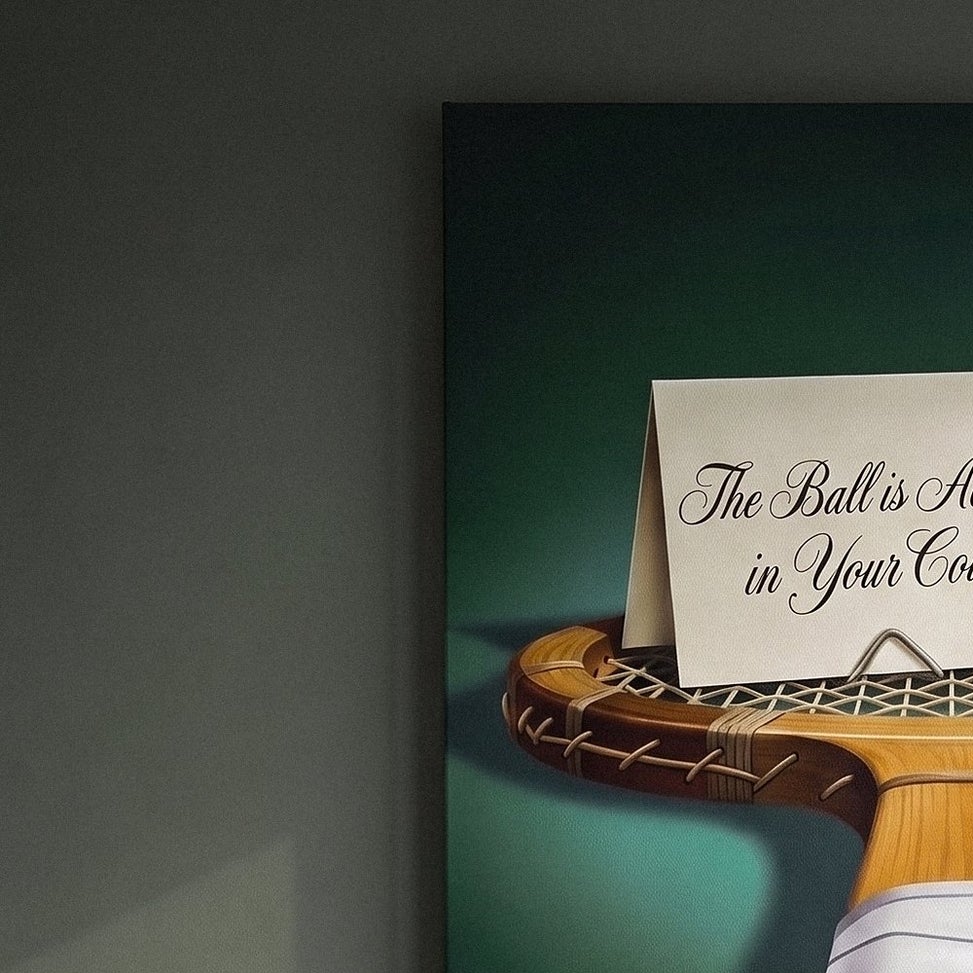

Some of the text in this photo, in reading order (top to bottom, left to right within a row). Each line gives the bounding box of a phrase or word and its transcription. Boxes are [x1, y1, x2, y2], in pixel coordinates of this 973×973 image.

[679, 460, 763, 526] The
[769, 459, 886, 520] Ball
[880, 472, 909, 512] is
[744, 552, 783, 596] in
[788, 532, 903, 615] Your
